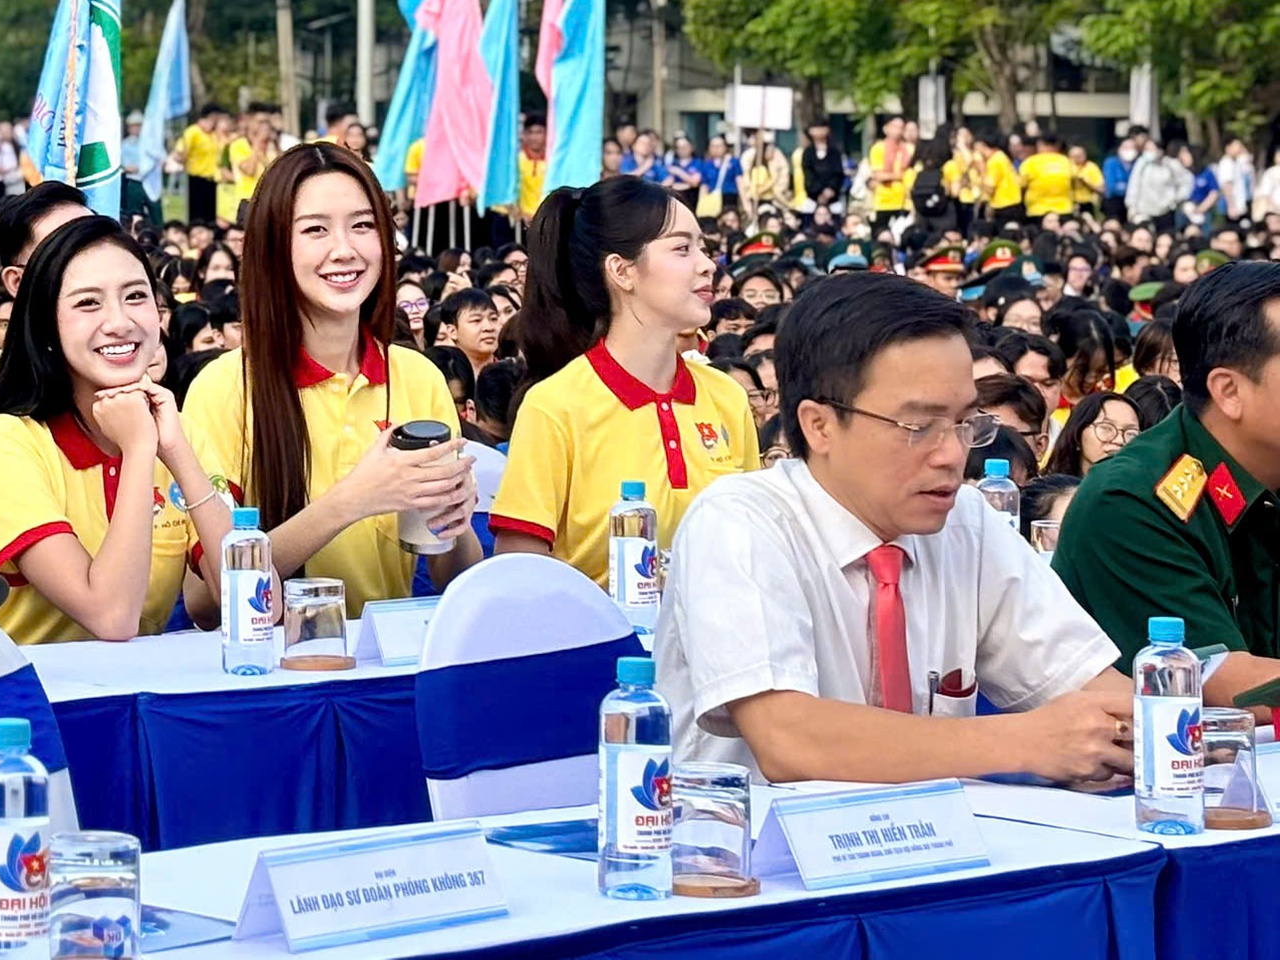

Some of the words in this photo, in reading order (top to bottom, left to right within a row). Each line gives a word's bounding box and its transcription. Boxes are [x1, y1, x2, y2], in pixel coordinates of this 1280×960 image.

[635, 815, 658, 828] ĐẠI
[828, 831, 864, 851] TRỊNH
[861, 827, 883, 847] THỊ
[880, 822, 908, 842] HIỀN
[289, 894, 321, 915] LÃNH
[322, 892, 345, 912] ĐẠO
[347, 888, 362, 906] SƯ
[363, 882, 394, 903] ĐOÀN
[394, 877, 431, 899] PHÒNG
[431, 871, 468, 893] KHÔNG
[468, 870, 486, 887] 367
